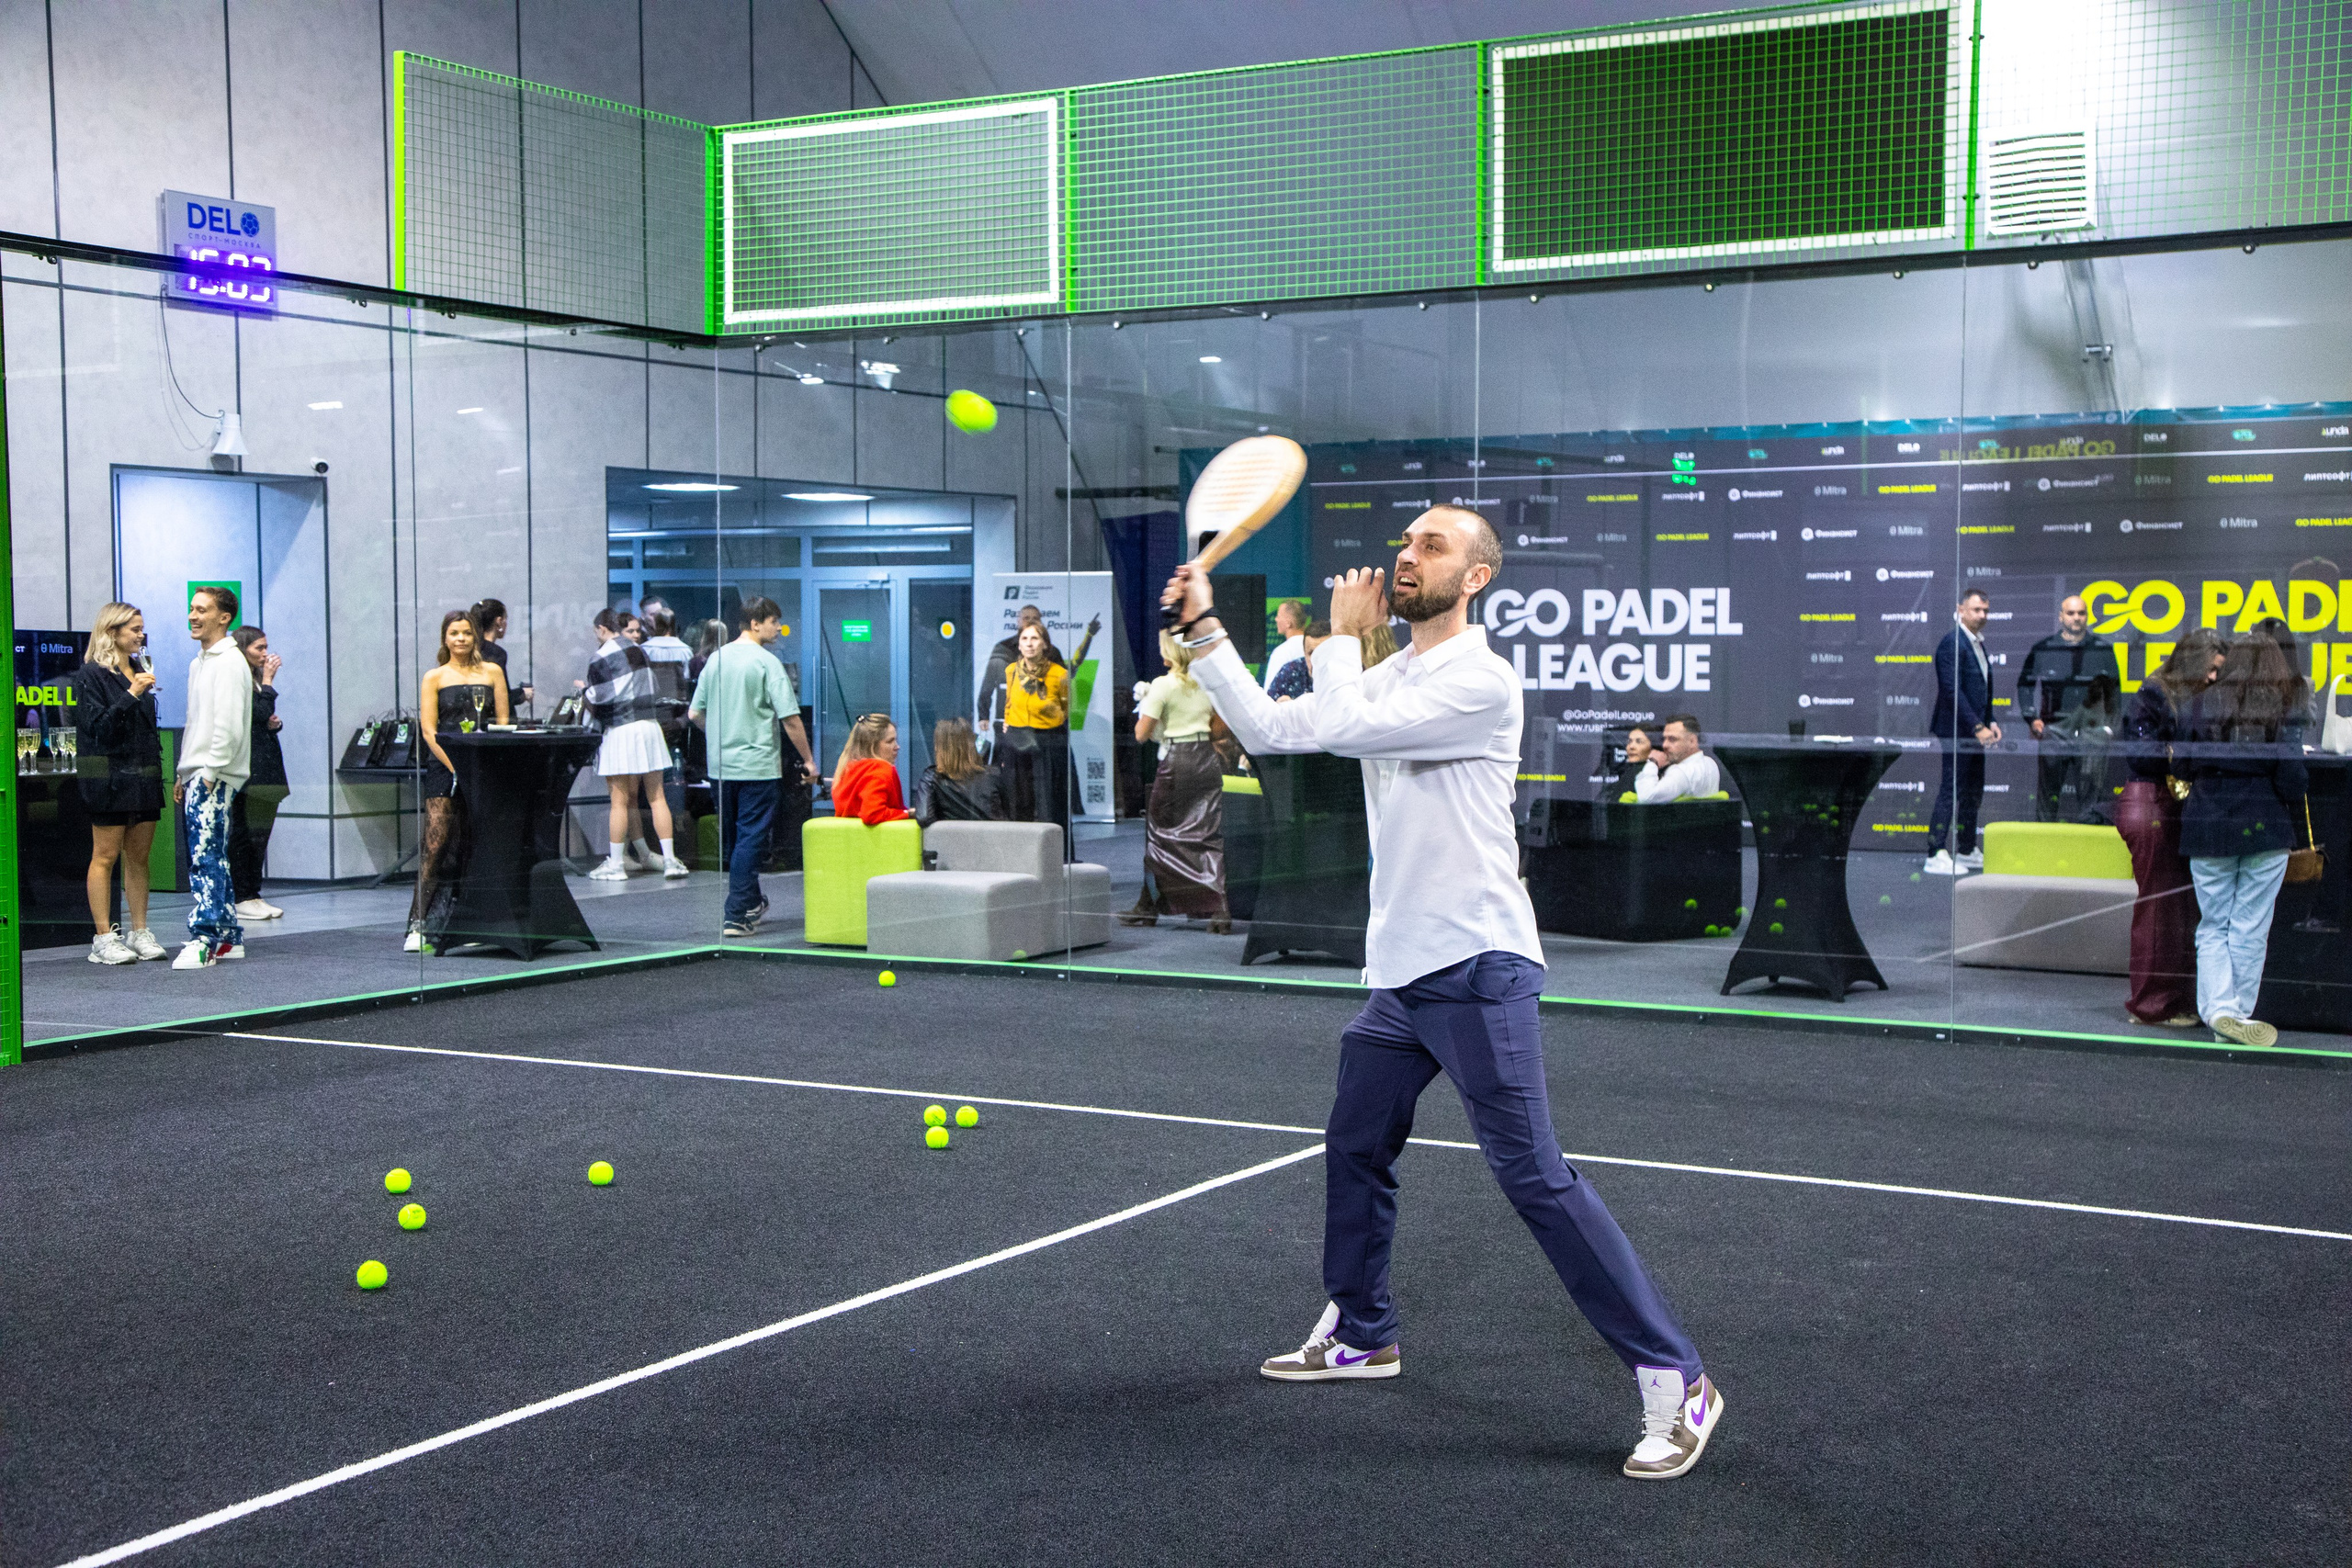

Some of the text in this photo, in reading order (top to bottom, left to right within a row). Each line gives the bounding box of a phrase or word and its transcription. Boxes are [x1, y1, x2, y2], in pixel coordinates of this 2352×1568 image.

[187, 201, 260, 238] DELO
[188, 232, 262, 250] СПОРТ-МОСКВА
[2230, 517, 2257, 527] Mitra
[1484, 587, 1743, 637] GO PADEL
[2079, 580, 2186, 635] GO
[49, 643, 74, 654] Mitra
[1513, 643, 1711, 692] LEAGUE
[16, 686, 62, 706] ADEL
[1563, 709, 1655, 722] @GoPadelLeague
